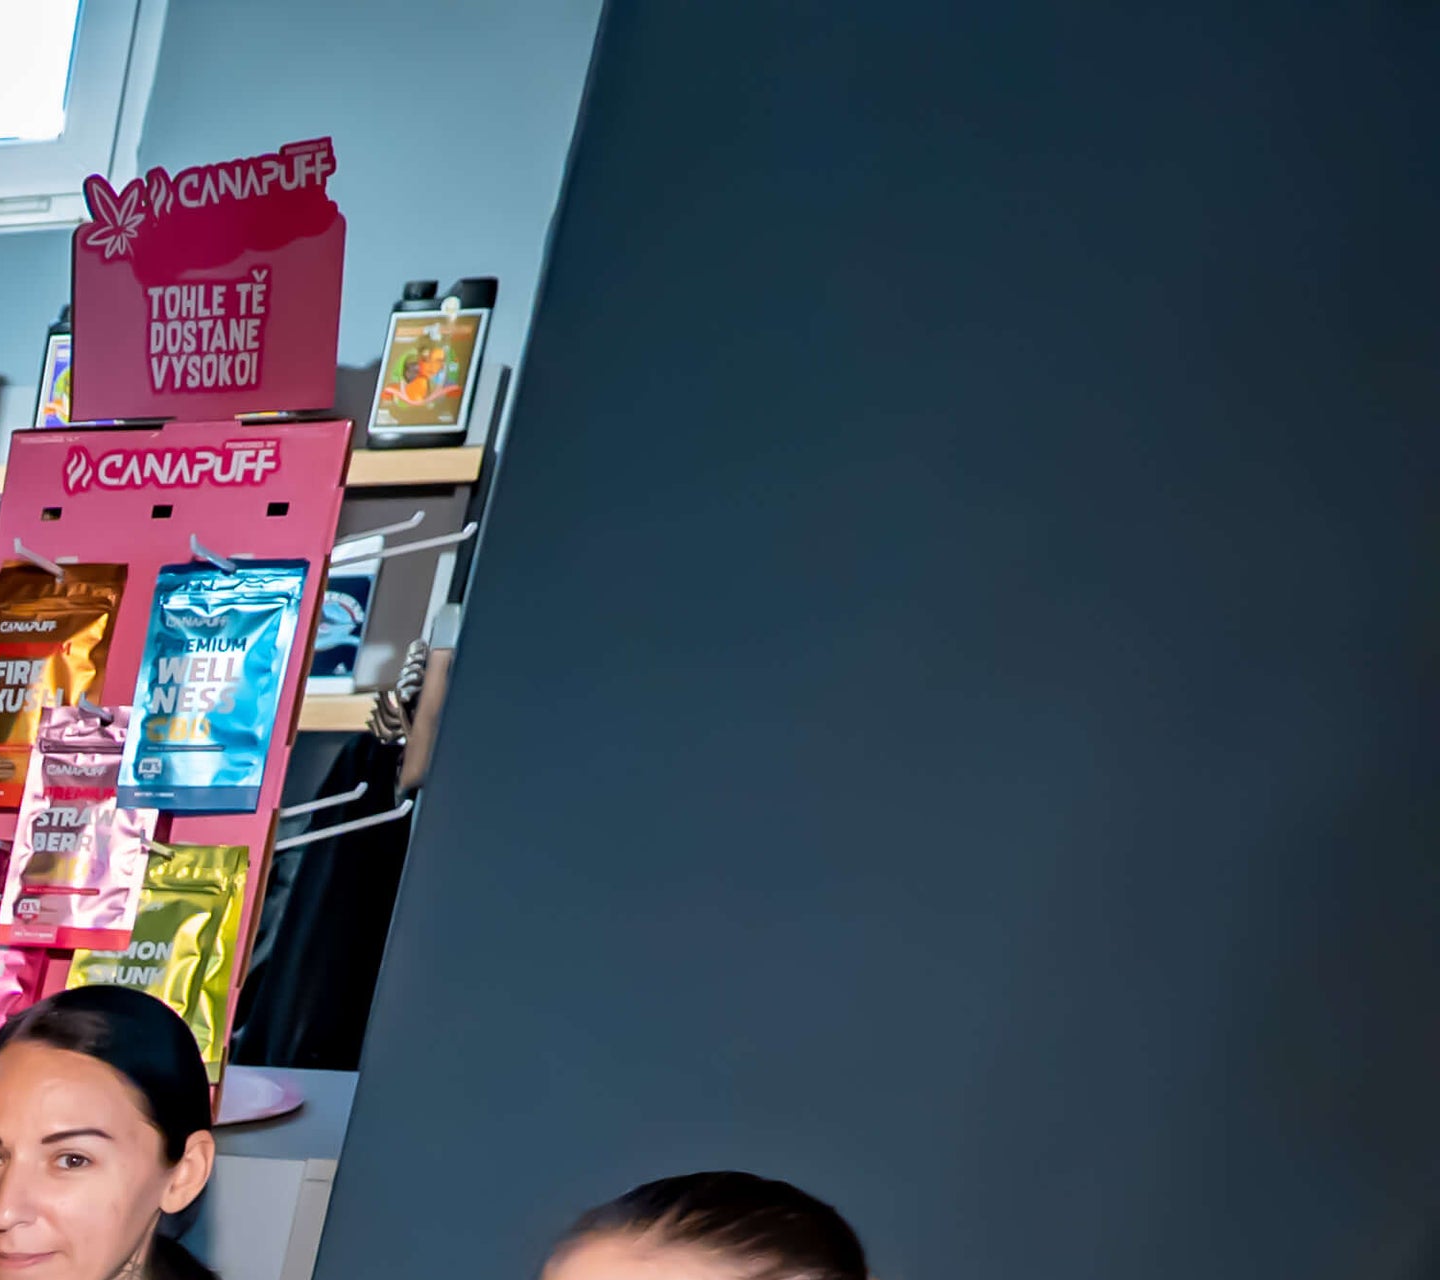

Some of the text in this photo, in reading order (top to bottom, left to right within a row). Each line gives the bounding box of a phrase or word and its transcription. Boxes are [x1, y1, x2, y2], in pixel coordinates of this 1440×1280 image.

[179, 150, 332, 209] CANAPUFF
[147, 269, 267, 320] TOHLE TĚ
[150, 318, 262, 354] DOSTANE
[151, 351, 259, 390] VYSOKO!
[97, 449, 277, 486] CANAPUFF
[158, 657, 241, 685] WELL
[150, 686, 238, 715] NESS
[146, 716, 212, 742] CBD
[36, 806, 117, 828] STRAW
